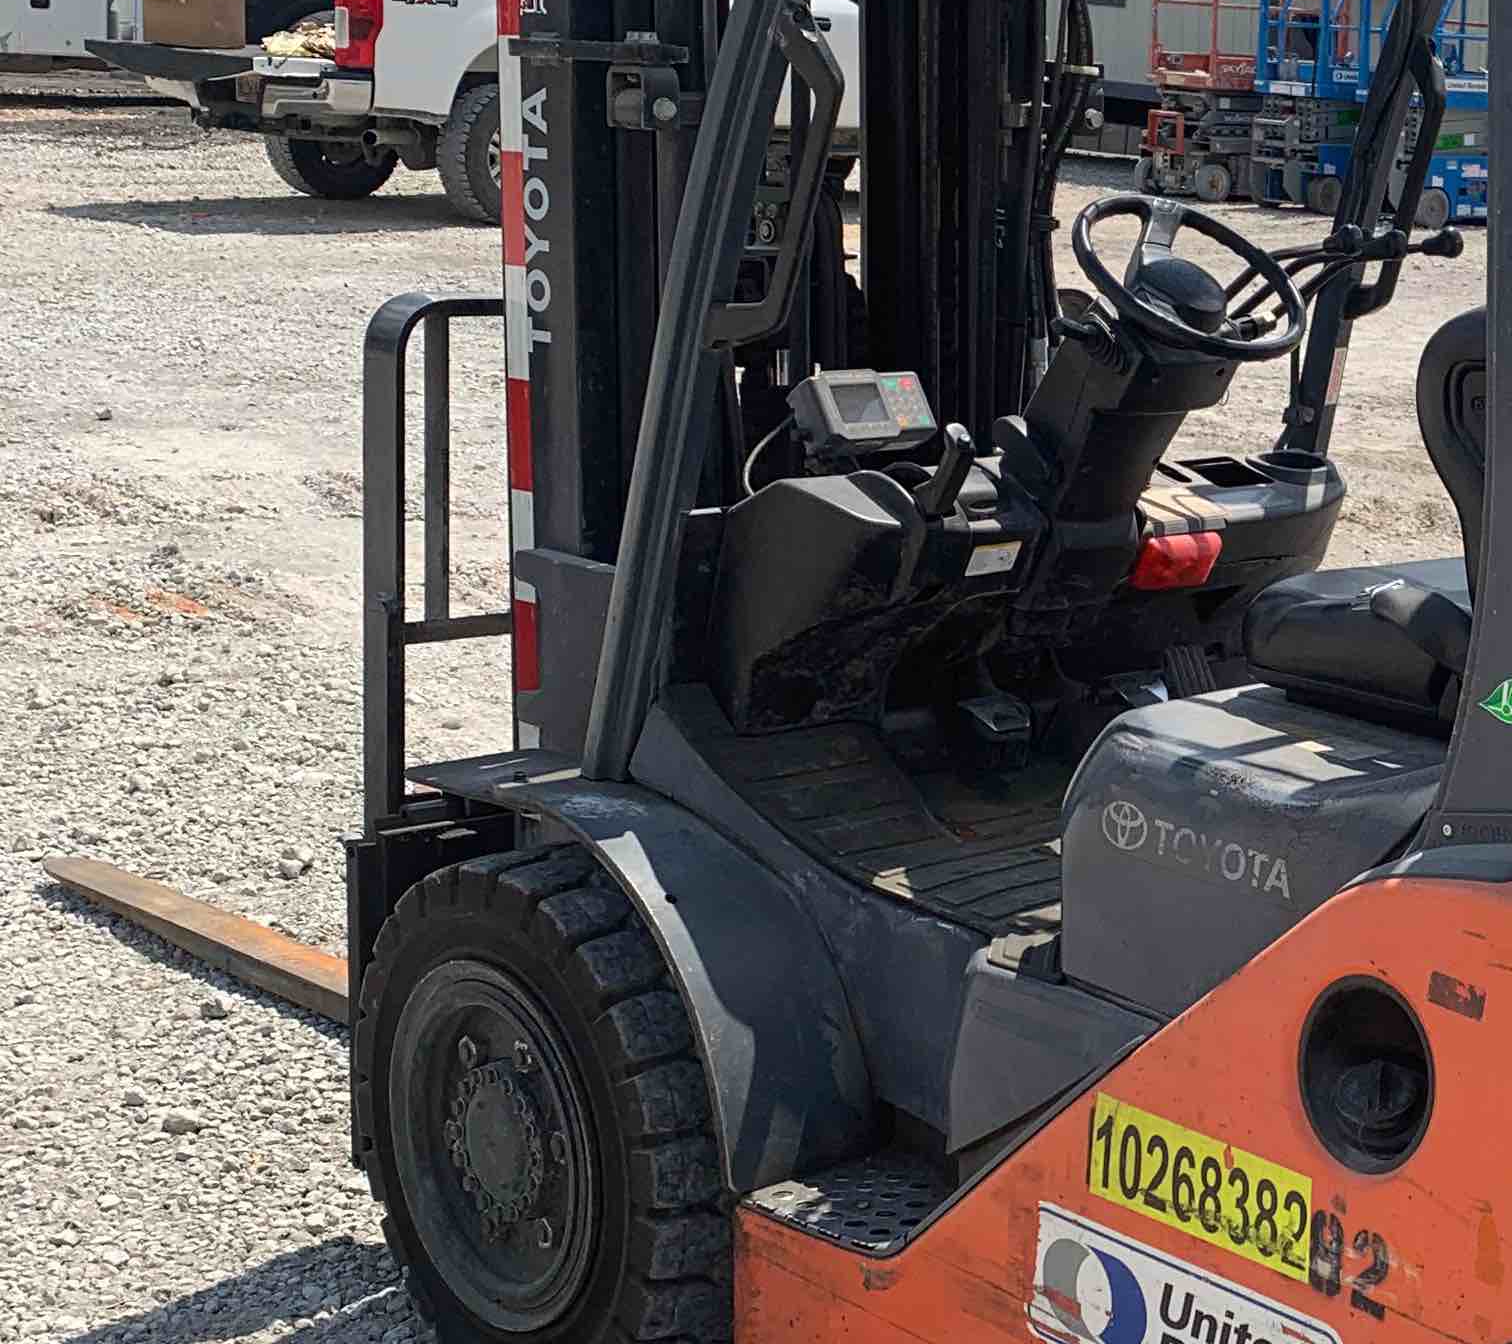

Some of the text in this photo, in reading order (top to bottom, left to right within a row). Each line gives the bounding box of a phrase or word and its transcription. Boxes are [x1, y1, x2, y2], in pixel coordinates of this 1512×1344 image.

[522, 87, 552, 353] TOYOTA
[1154, 818, 1290, 900] TOYOTA
[1096, 1114, 1308, 1271] 10268382
